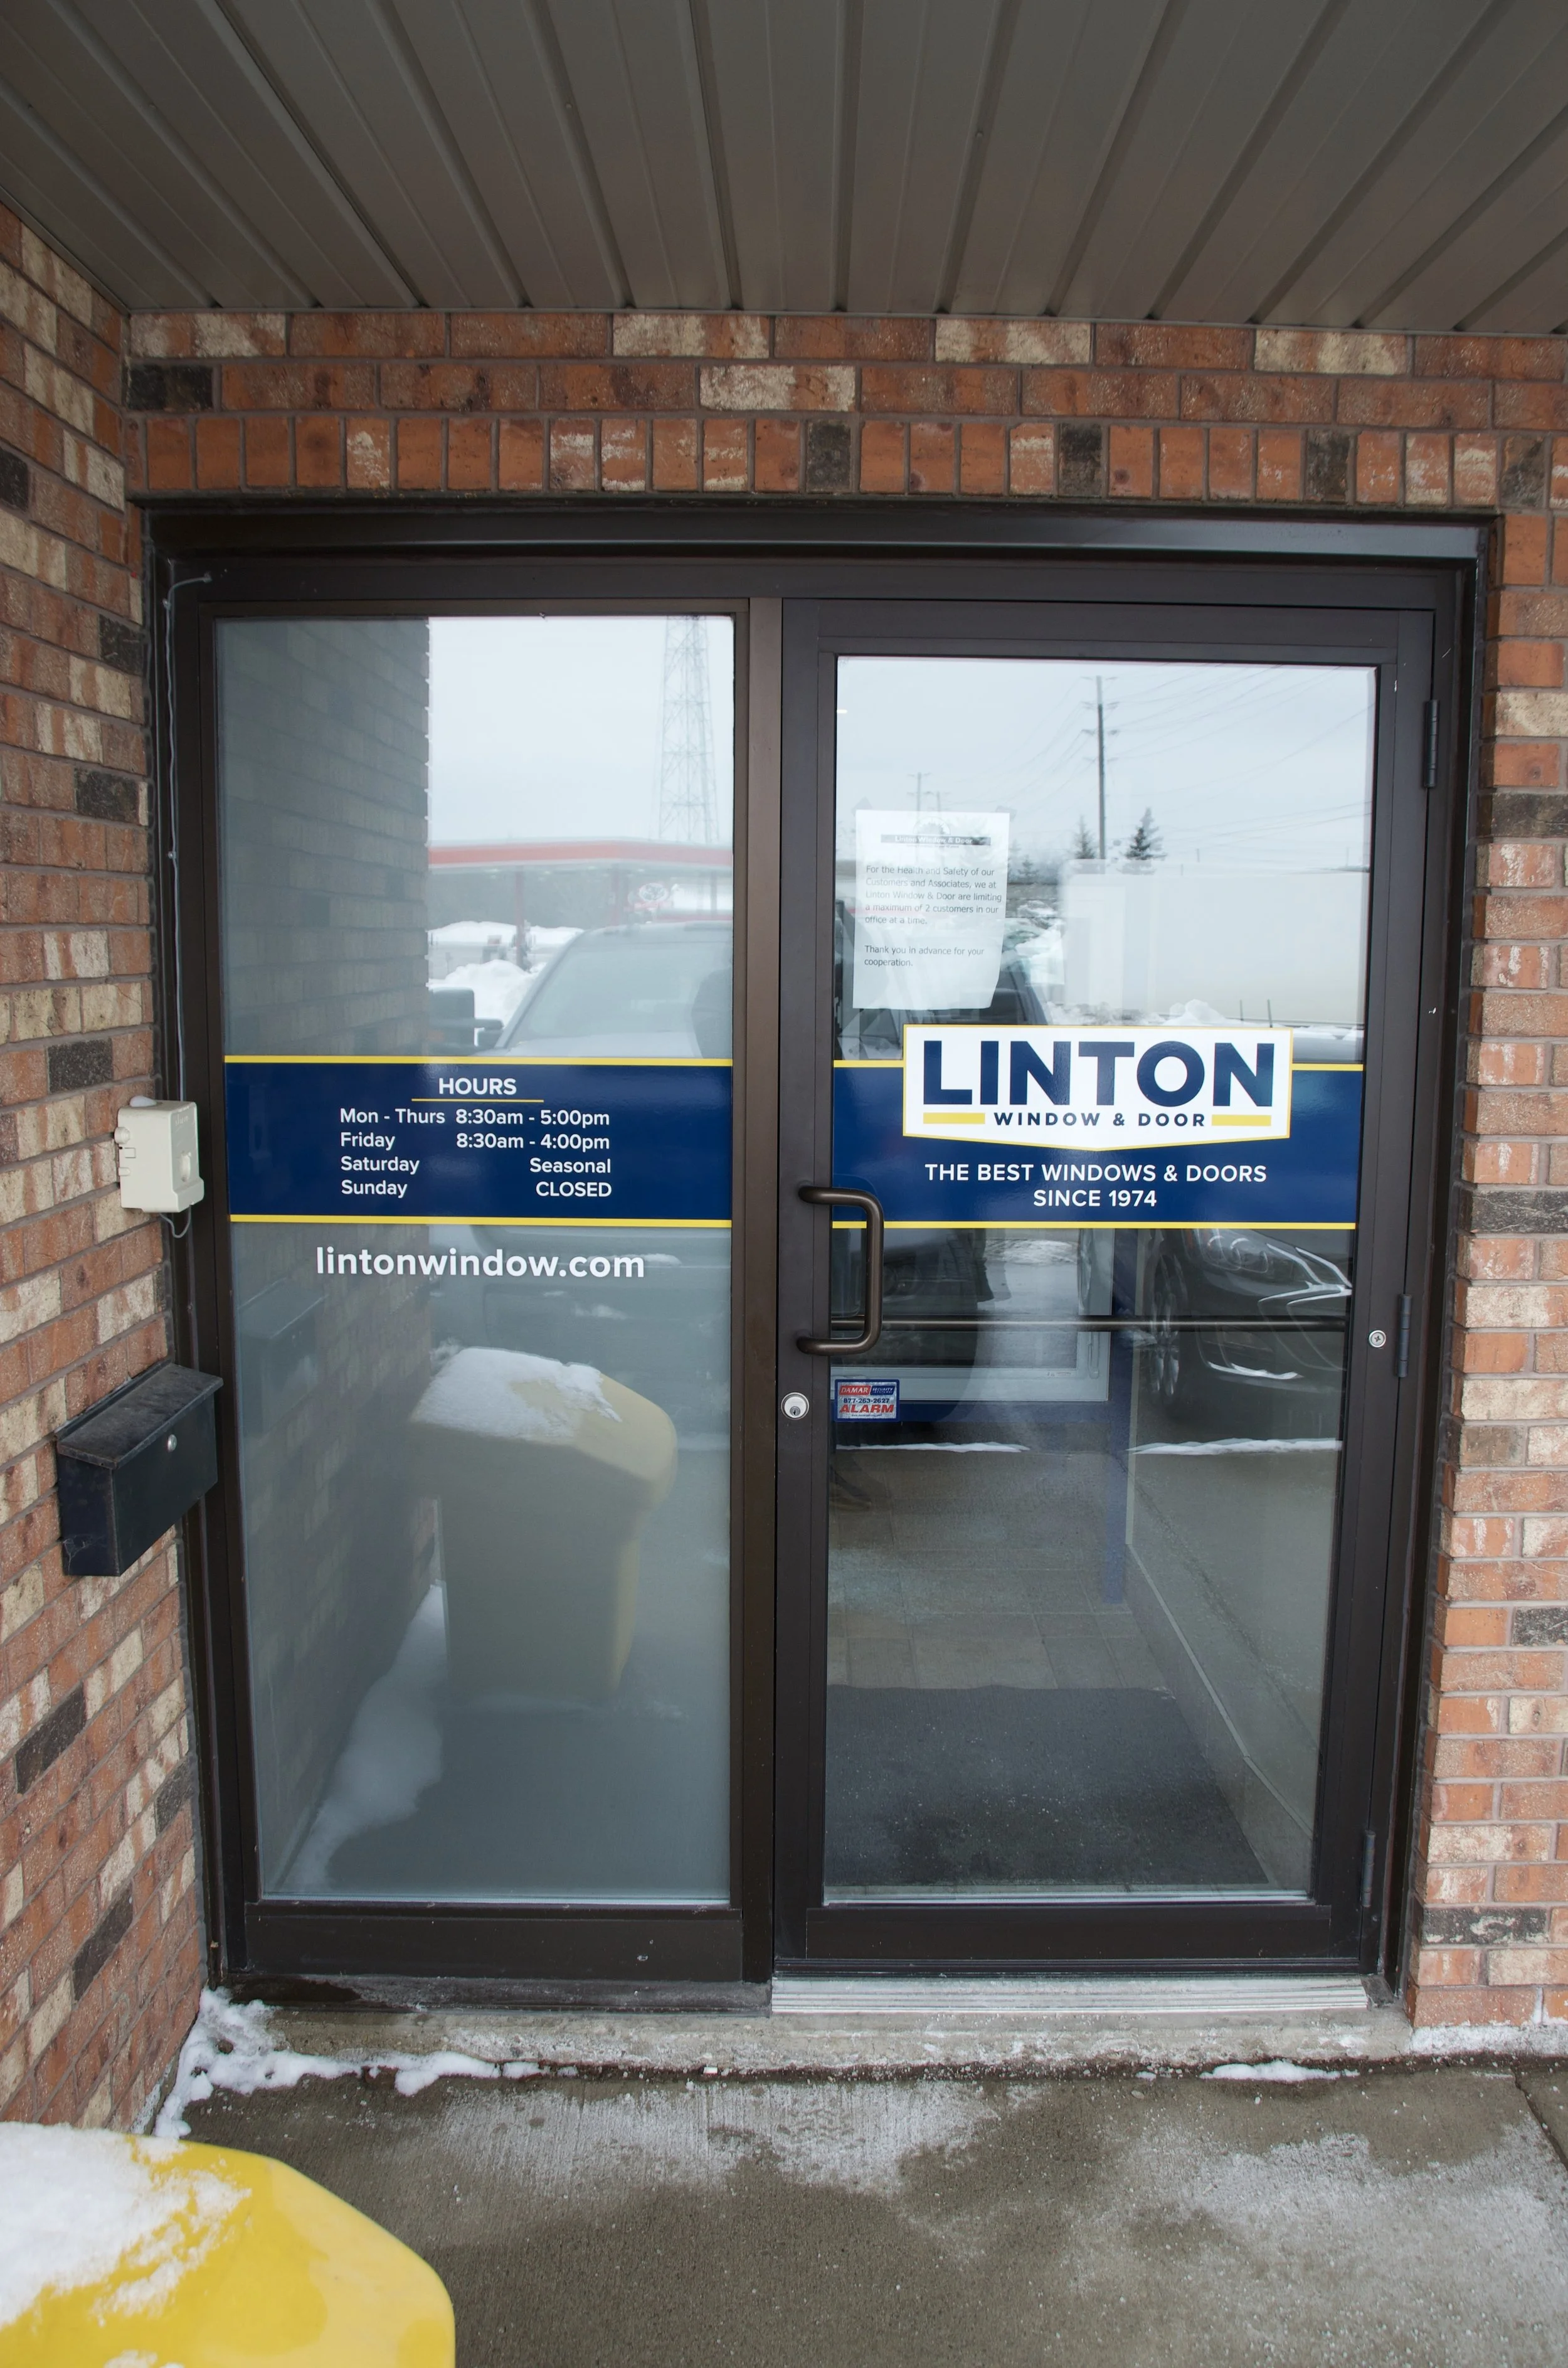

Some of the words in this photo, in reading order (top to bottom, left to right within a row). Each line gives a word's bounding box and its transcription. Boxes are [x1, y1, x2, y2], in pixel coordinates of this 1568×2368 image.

[943, 868, 968, 876] Safety
[866, 878, 908, 886] Customers
[928, 880, 972, 889] Associates,
[974, 893, 1002, 902] limiting
[892, 947, 906, 955] you
[864, 958, 913, 967] cooperation.
[923, 1041, 1274, 1107] LINTON
[438, 1078, 517, 1095] HOURS
[340, 1108, 379, 1123] Mon
[395, 1109, 445, 1124] Thurs
[456, 1109, 523, 1125] 8:30am
[540, 1110, 610, 1128] 5:00pm
[994, 1112, 1100, 1126] WINDOW
[1113, 1113, 1125, 1127] &
[1138, 1113, 1205, 1127] DOOR
[341, 1132, 395, 1150] Friday
[457, 1134, 524, 1149] 8:30am
[541, 1134, 610, 1152] 4:00pm
[341, 1157, 420, 1175] Saturday
[530, 1158, 611, 1173] Seasonal
[924, 1164, 969, 1181] THE
[978, 1164, 1034, 1181] BEST
[1041, 1164, 1155, 1182] WINDOWS
[1163, 1165, 1177, 1182] &
[1187, 1165, 1266, 1182] DOORS
[341, 1181, 408, 1198] Sunday
[536, 1182, 612, 1197] CLOSED
[1034, 1190, 1100, 1207] SINCE
[1108, 1191, 1157, 1207] 1974
[317, 1247, 645, 1278] lintonwindow.com
[840, 1404, 894, 1413] ALARM
